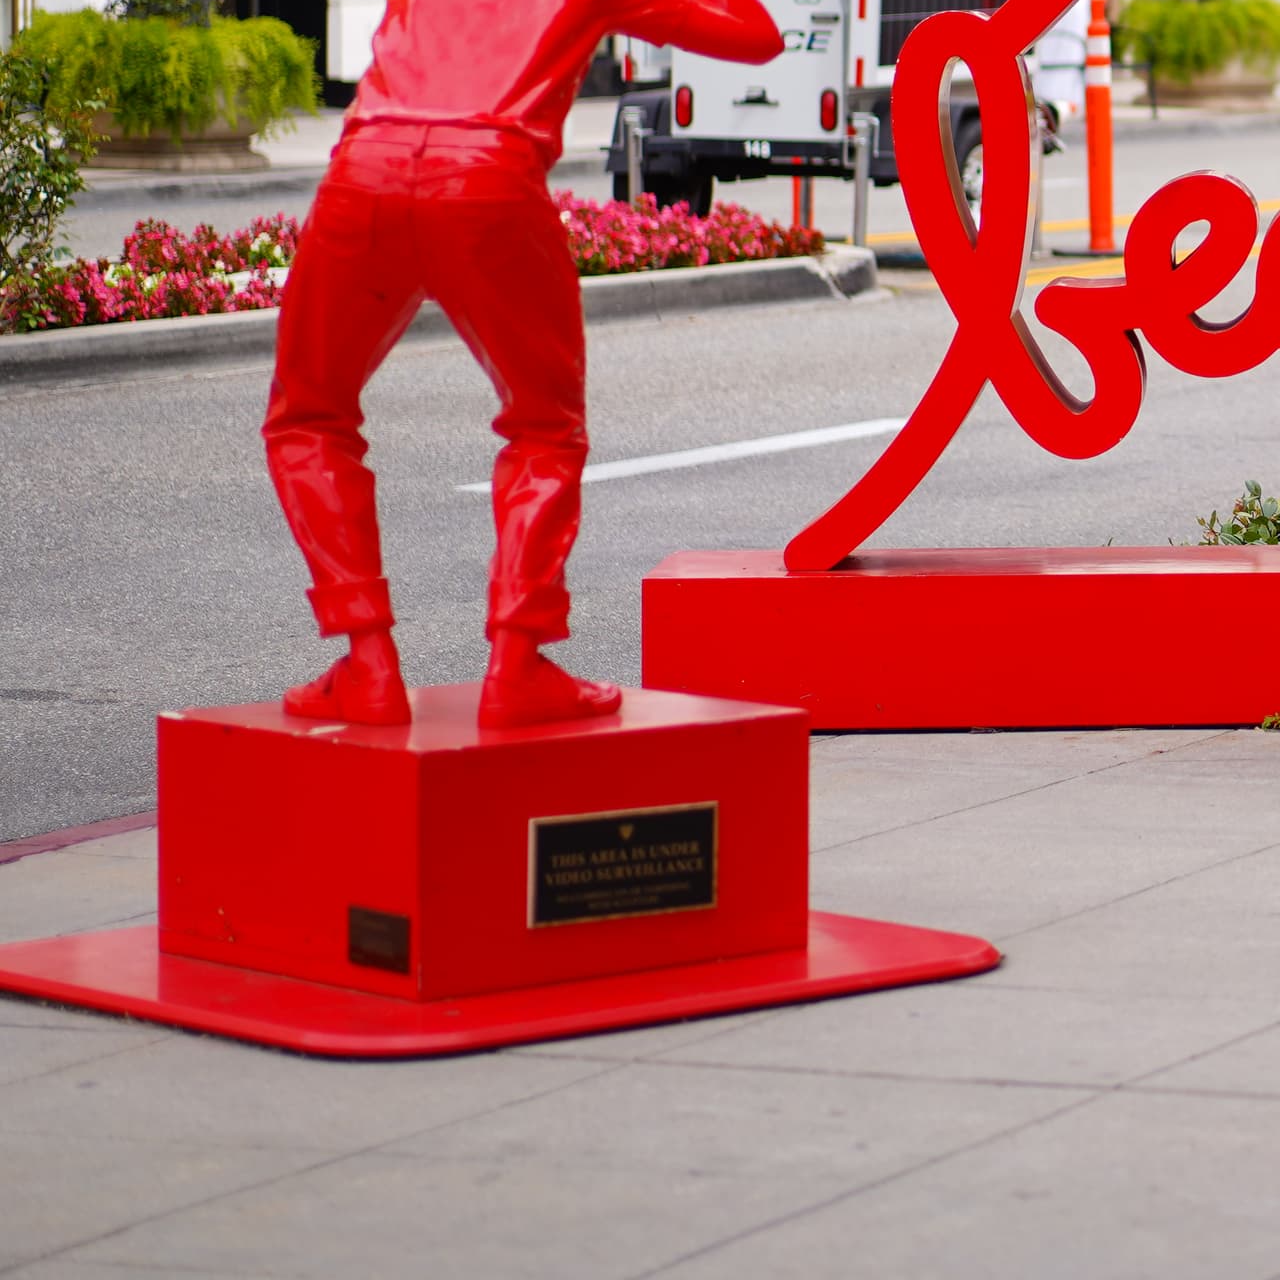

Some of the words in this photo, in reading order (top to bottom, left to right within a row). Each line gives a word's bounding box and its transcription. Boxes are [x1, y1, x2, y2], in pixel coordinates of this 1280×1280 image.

[550, 853, 587, 868] THIS
[590, 848, 628, 864] AREA
[631, 846, 646, 860] IS
[649, 840, 700, 857] UNDER
[544, 869, 593, 886] VIDEO
[596, 857, 705, 880] SURVEILLANCE
